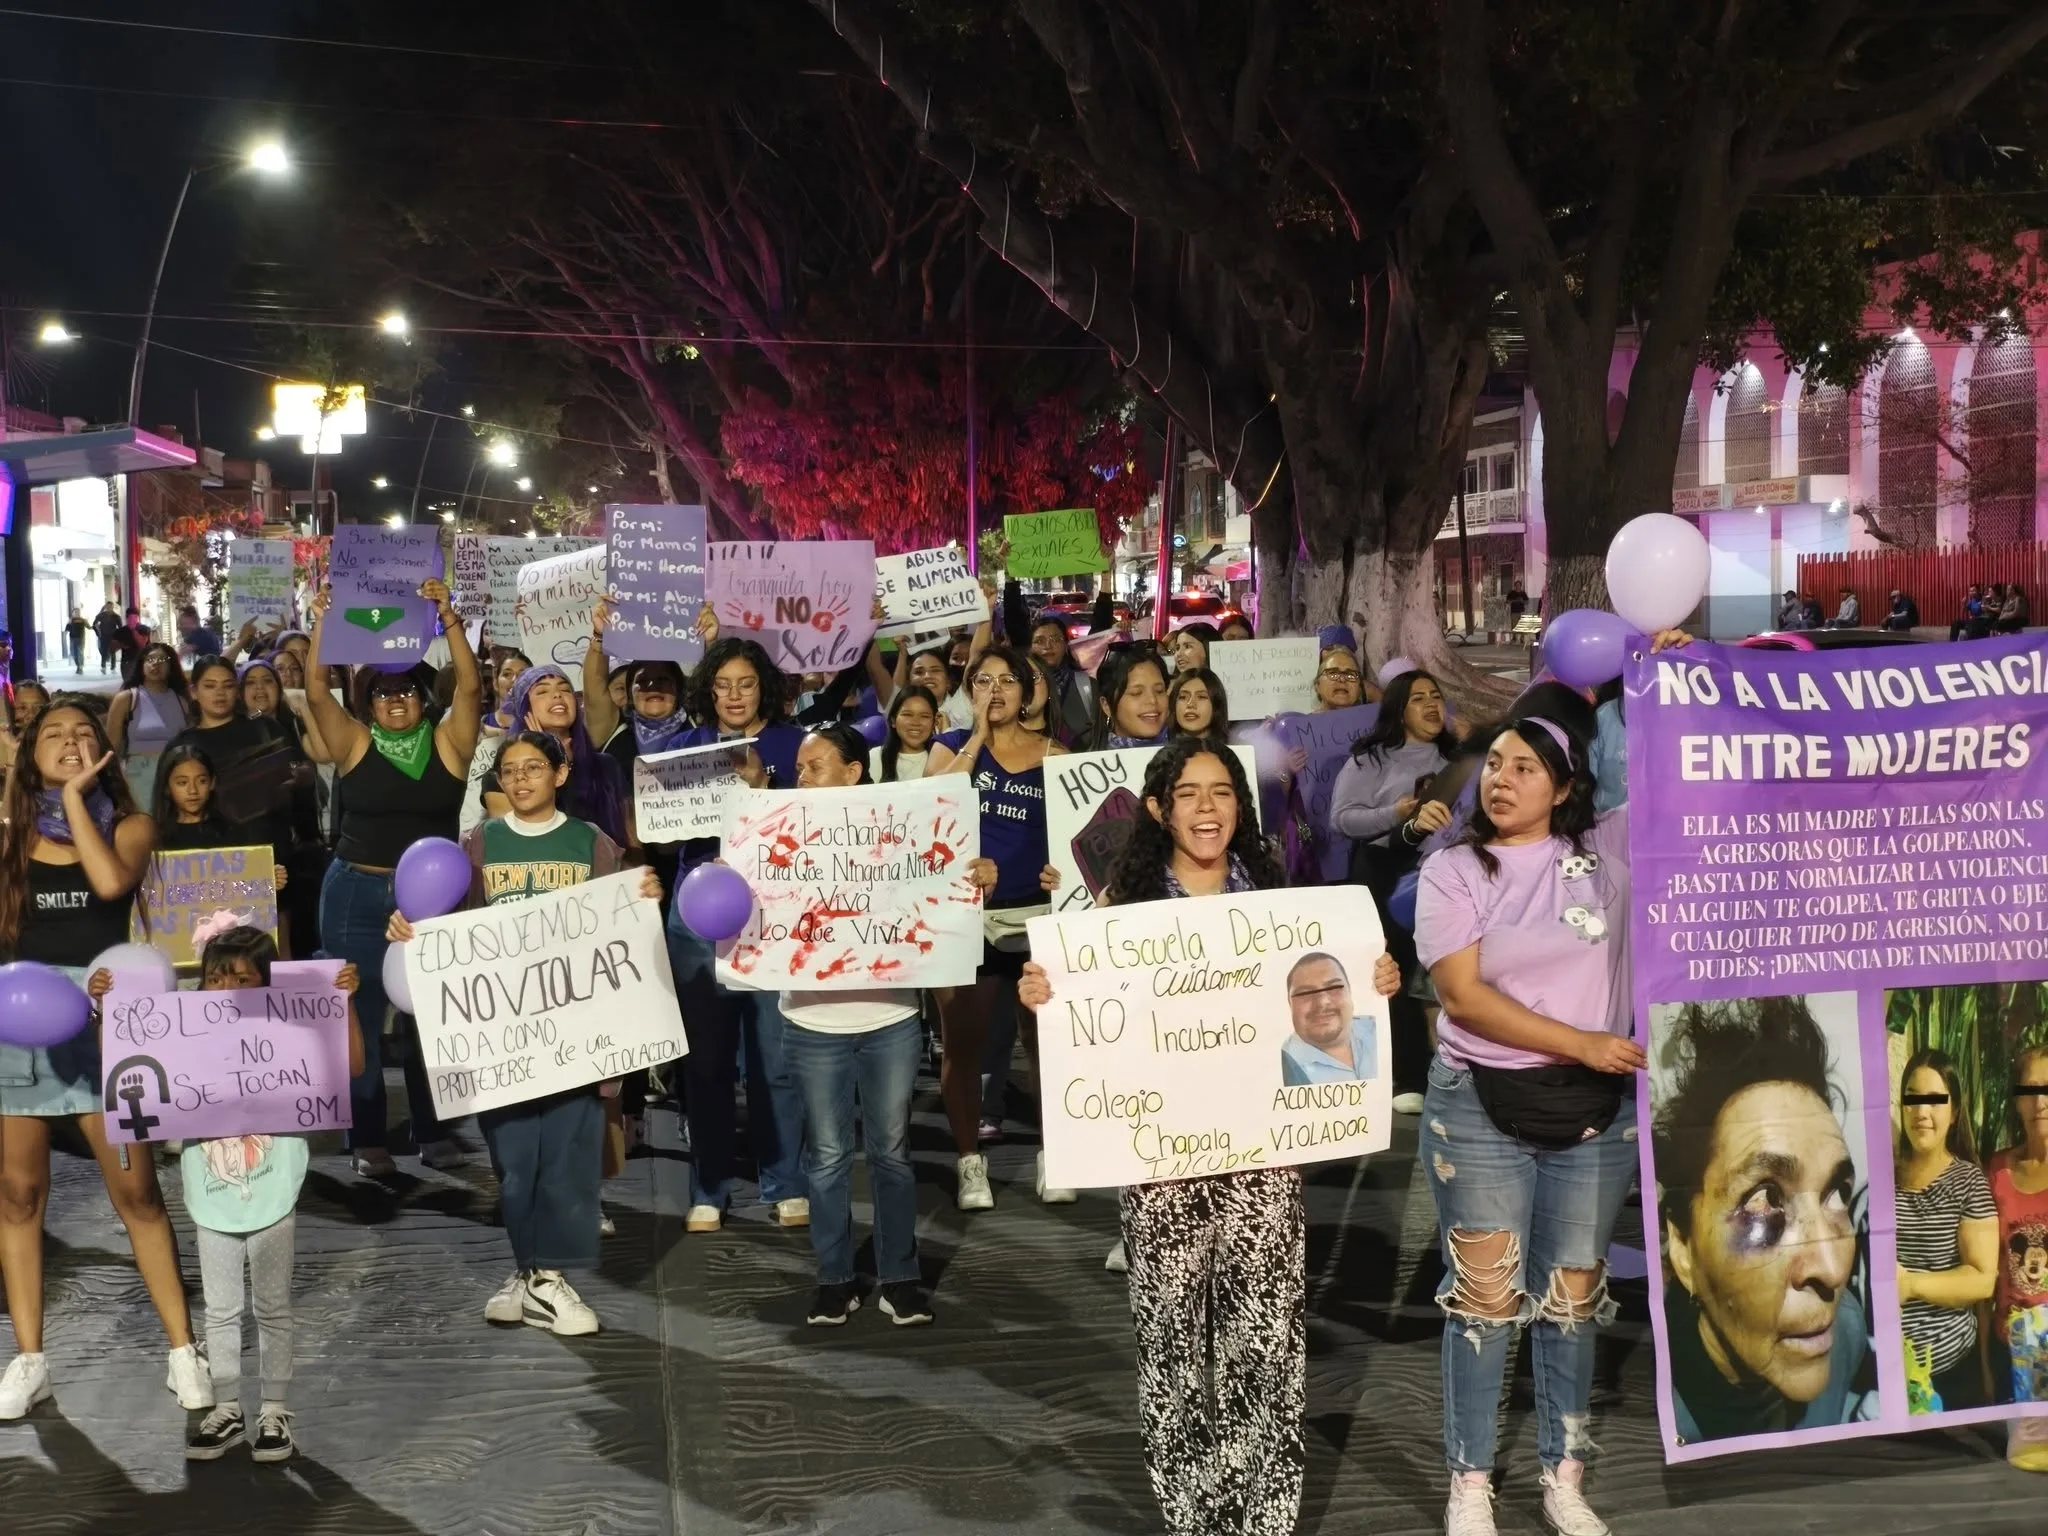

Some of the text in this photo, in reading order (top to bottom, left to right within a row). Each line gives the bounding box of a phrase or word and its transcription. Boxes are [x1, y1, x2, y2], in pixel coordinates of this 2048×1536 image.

[1756, 482, 1780, 494] STATION
[612, 510, 638, 530] Por
[337, 548, 358, 567] No
[457, 537, 479, 550] UN
[612, 533, 636, 549] Por
[640, 536, 697, 552] Mamá
[456, 561, 470, 571] ES
[611, 550, 635, 568] Por
[905, 551, 958, 569] ABUSO
[356, 580, 407, 597] Madre
[359, 570, 374, 580] de
[456, 582, 478, 591] QUE
[618, 571, 638, 582] na
[608, 582, 633, 602] Por
[908, 589, 976, 617] SILENCIO
[611, 611, 636, 631] Por
[775, 595, 812, 625] NO
[521, 615, 547, 637] Por
[1657, 649, 2048, 712] NO A LA VIOLENCI
[1680, 723, 2031, 782] ENTRE MUJERES
[697, 775, 711, 789] de
[975, 770, 998, 790] Si
[1058, 753, 1127, 811] HOY
[642, 797, 685, 811] madres
[690, 794, 705, 806] no
[980, 801, 1028, 820] a una
[1682, 798, 2045, 837] ELLA ES MI MADRE Y ELLAS SON LAS
[801, 806, 906, 847] Luchando
[1697, 827, 2033, 866] AGRESORAS QUE LA GOLPEARON.
[482, 864, 529, 901] NEW
[757, 844, 791, 881] Para
[832, 852, 900, 891] Ninguna
[1667, 870, 1745, 900] ¡BASTA
[1750, 869, 1779, 893] DE
[1785, 862, 1914, 892] NORMALIZAR
[1919, 860, 1944, 882] LA
[36, 892, 89, 909] SMILEY
[816, 885, 871, 913] Viva
[1648, 902, 1668, 925] SI
[1673, 899, 1768, 924] ALGUIEN
[1773, 897, 1800, 919] TE
[1804, 892, 1889, 918] GOLPEA,
[1893, 889, 1918, 911] TE
[1922, 886, 1987, 909] GRITA
[1991, 884, 2007, 905] O
[416, 883, 642, 973] EDUQUEMOS A
[759, 908, 788, 941] Lo
[797, 911, 836, 943] Que
[1670, 926, 1792, 954] CUALQUIER
[1797, 922, 1846, 945] TIPO
[1851, 920, 1878, 943] DE
[1882, 908, 1993, 940] AGRESIÓN,
[1998, 911, 2031, 933] NO
[1056, 908, 1324, 974] La Escuela Debía
[1688, 936, 2048, 981] DUDES: ¡DENUNCIA DE INMEDIATO!
[441, 938, 642, 1026] NO VIOLAR
[240, 1034, 275, 1065] NO
[437, 1017, 557, 1066] NO A COMO
[437, 1033, 616, 1105] PROTEJERSE de una
[592, 1038, 682, 1078] VIOLACION
[1064, 1077, 1164, 1130] Colegio
[1133, 1123, 1231, 1163] Chapala
[1269, 1116, 1369, 1152] VIOLADOR
